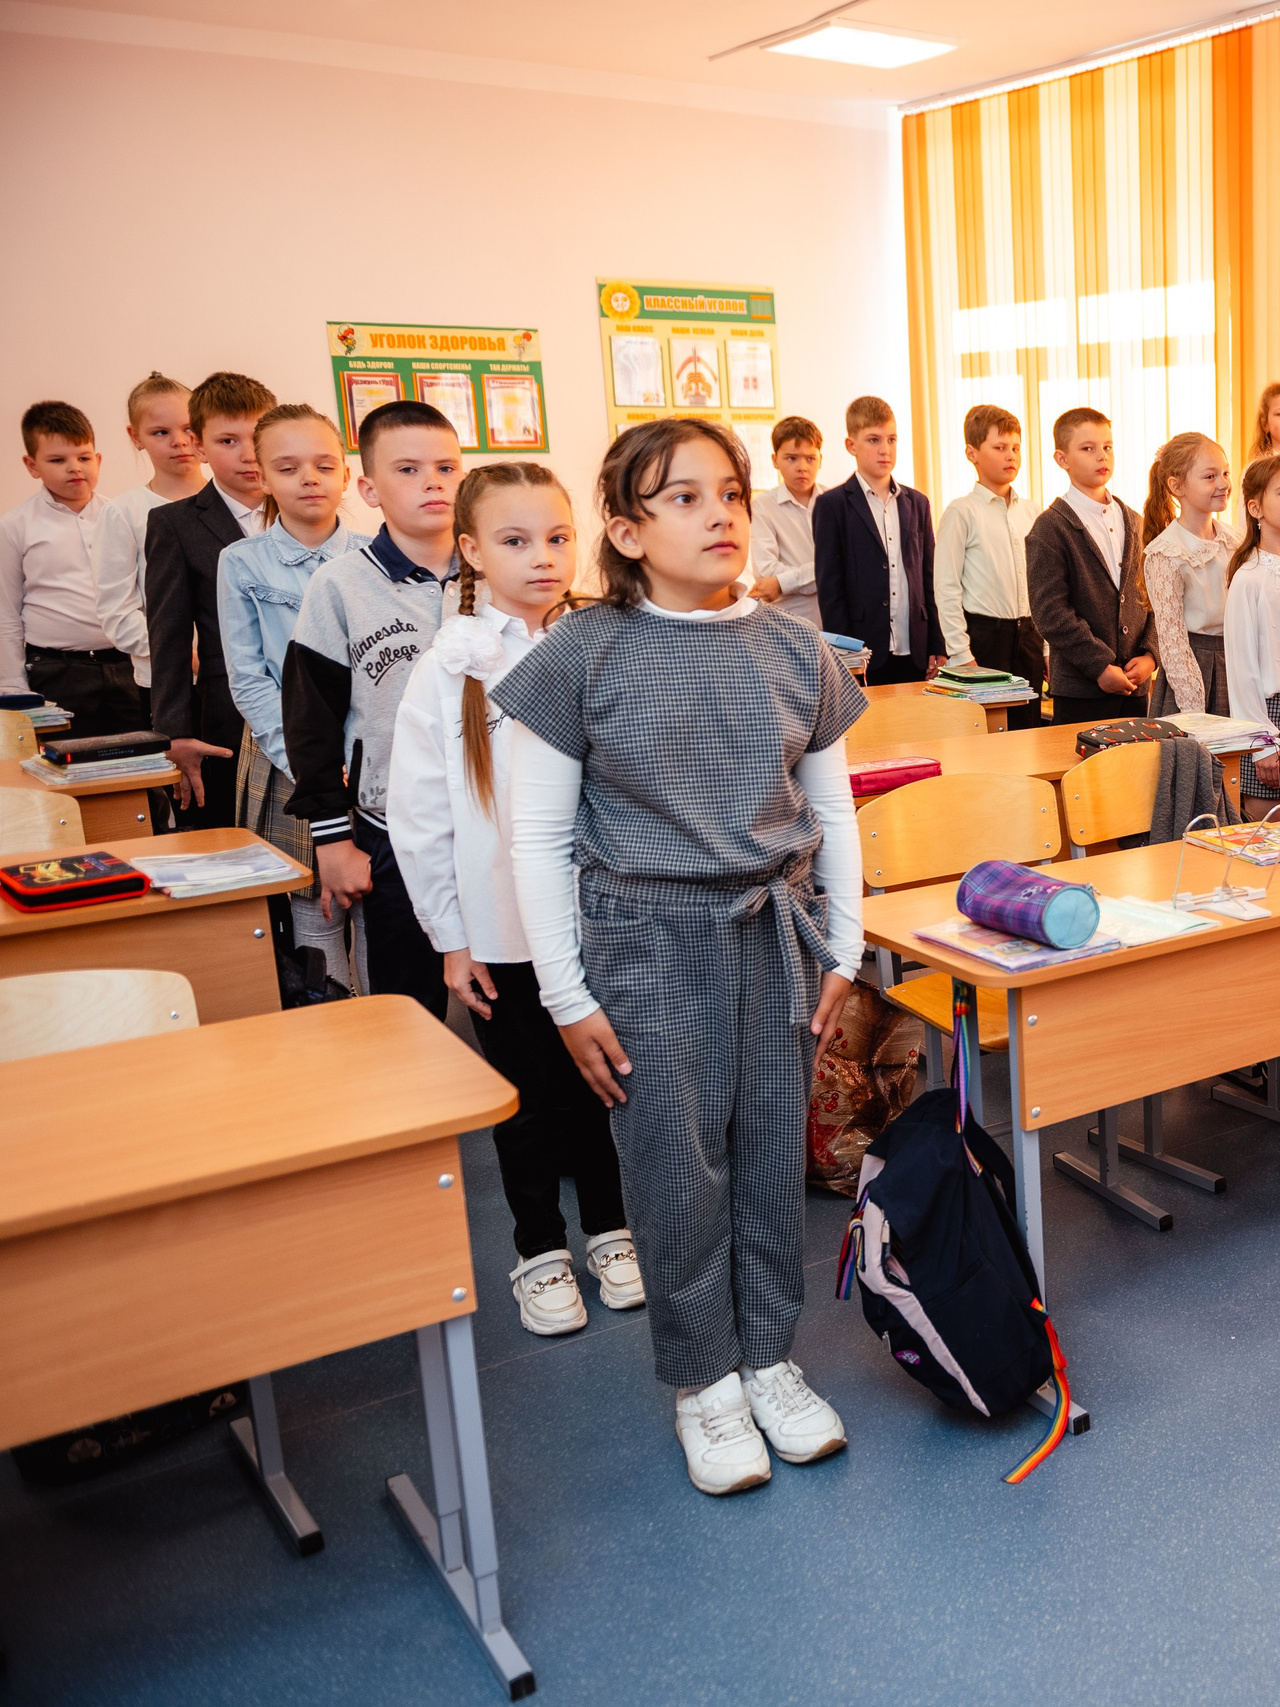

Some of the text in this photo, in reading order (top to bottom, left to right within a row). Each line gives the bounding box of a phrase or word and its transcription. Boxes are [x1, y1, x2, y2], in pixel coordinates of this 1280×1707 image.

[644, 295, 747, 315] КЛАССНЫЙ УГОЛОК
[369, 333, 506, 352] УГОЛОК ЗДОРОВЬЯ
[348, 360, 394, 370] БУДЬ ЗДОРОВ!
[364, 643, 420, 680] College
